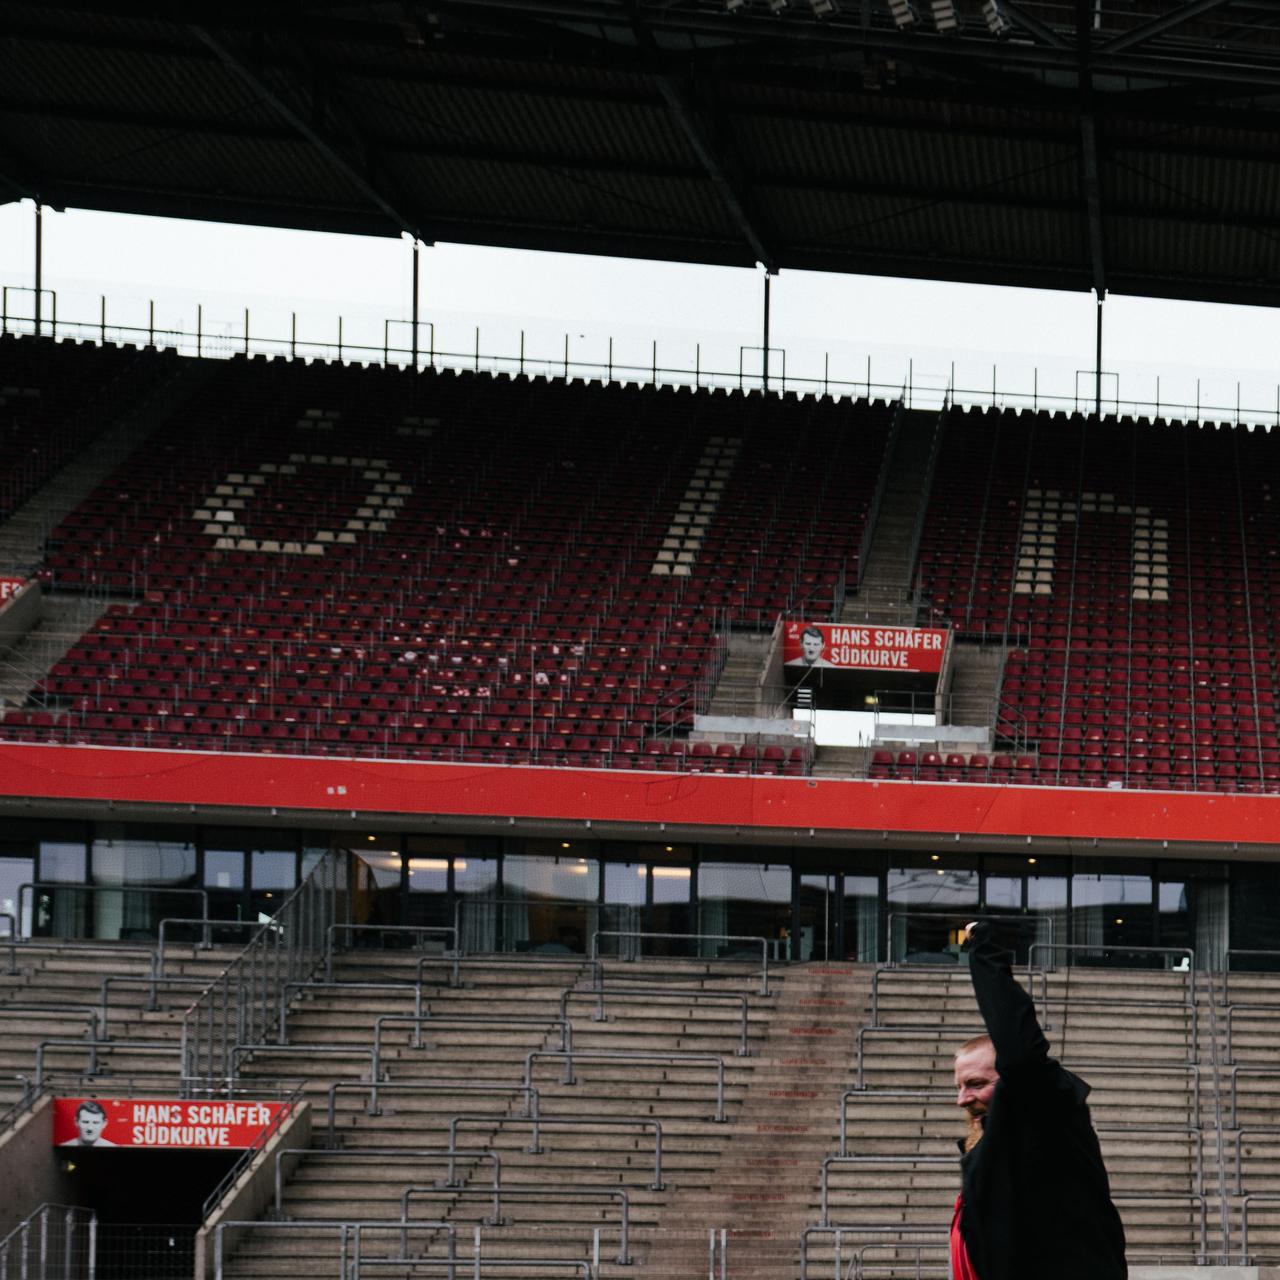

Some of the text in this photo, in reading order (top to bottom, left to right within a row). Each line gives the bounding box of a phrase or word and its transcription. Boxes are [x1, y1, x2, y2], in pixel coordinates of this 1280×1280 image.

[831, 628, 942, 650] HANS SCHÄFER
[830, 646, 909, 668] SÜDKURVE
[133, 1103, 271, 1126] HANS SCHÄFER
[132, 1121, 230, 1146] SÜDKURVE
